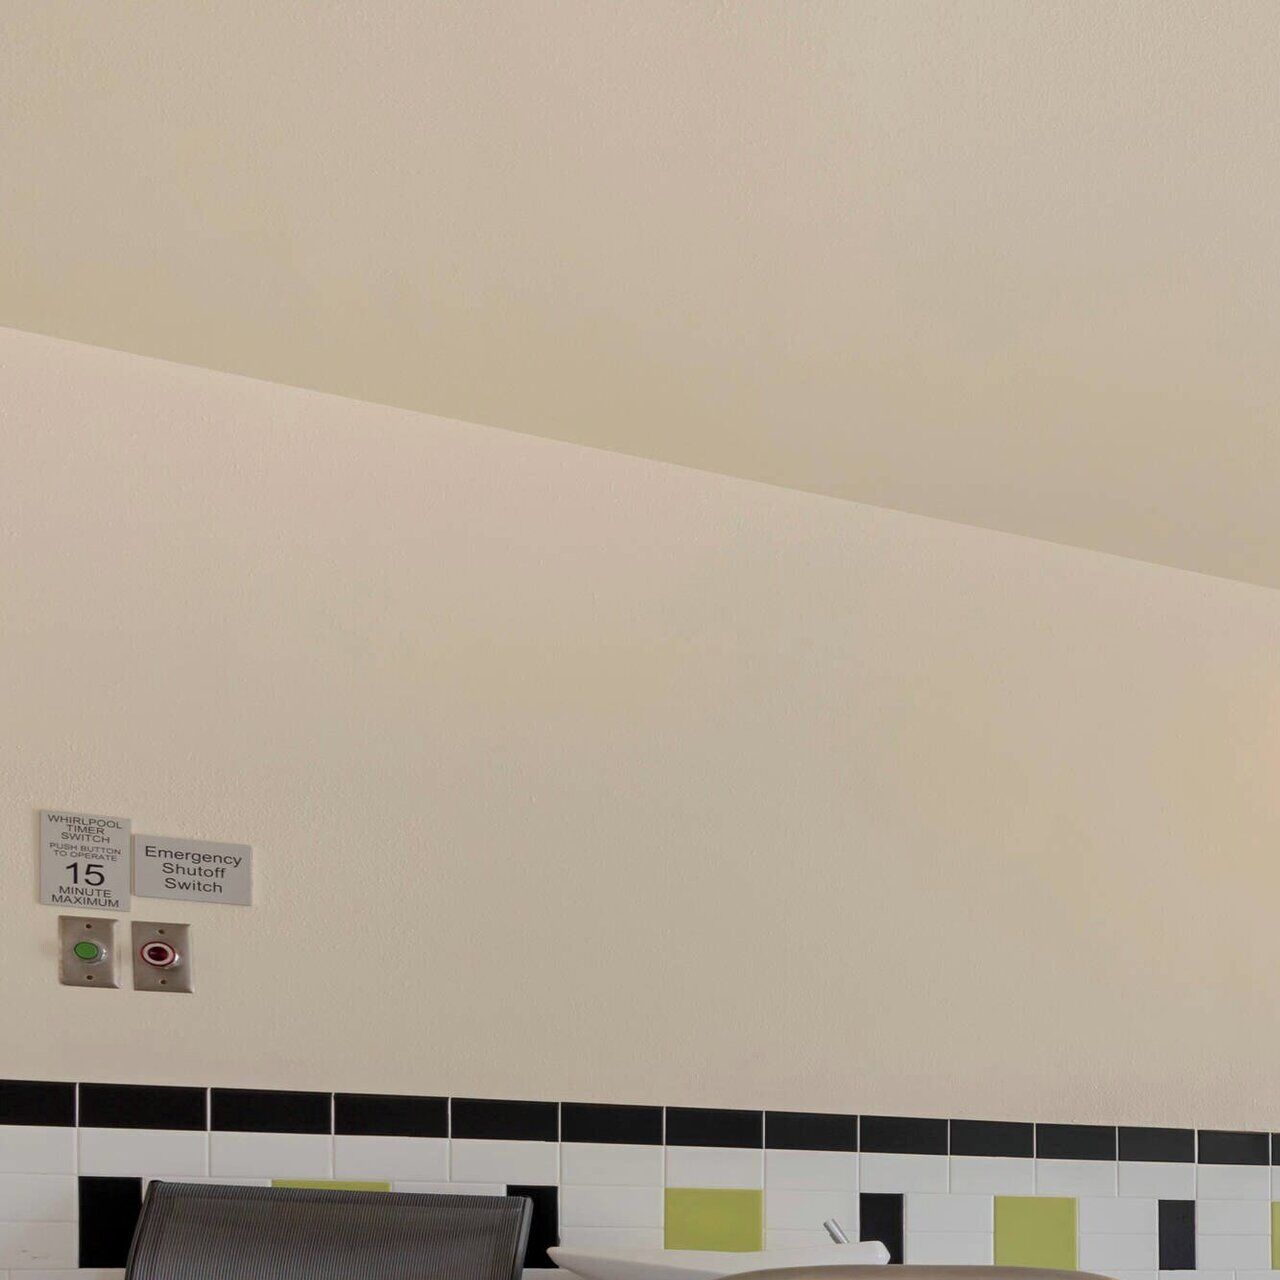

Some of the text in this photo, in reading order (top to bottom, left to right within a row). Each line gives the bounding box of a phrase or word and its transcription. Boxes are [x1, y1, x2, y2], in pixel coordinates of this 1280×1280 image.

[47, 814, 123, 829] WHIRLPOOL
[66, 824, 105, 835] TIMER
[61, 832, 110, 844] SWITCH
[49, 842, 121, 855] PUSH BUTTON
[54, 849, 118, 862] TO OPERATE
[144, 845, 243, 869] Emergency
[65, 862, 105, 887] 15
[162, 862, 227, 879] Shutoff
[58, 885, 113, 898] MINUTE
[164, 877, 223, 894] Switch
[51, 894, 120, 908] MAXIMUM
